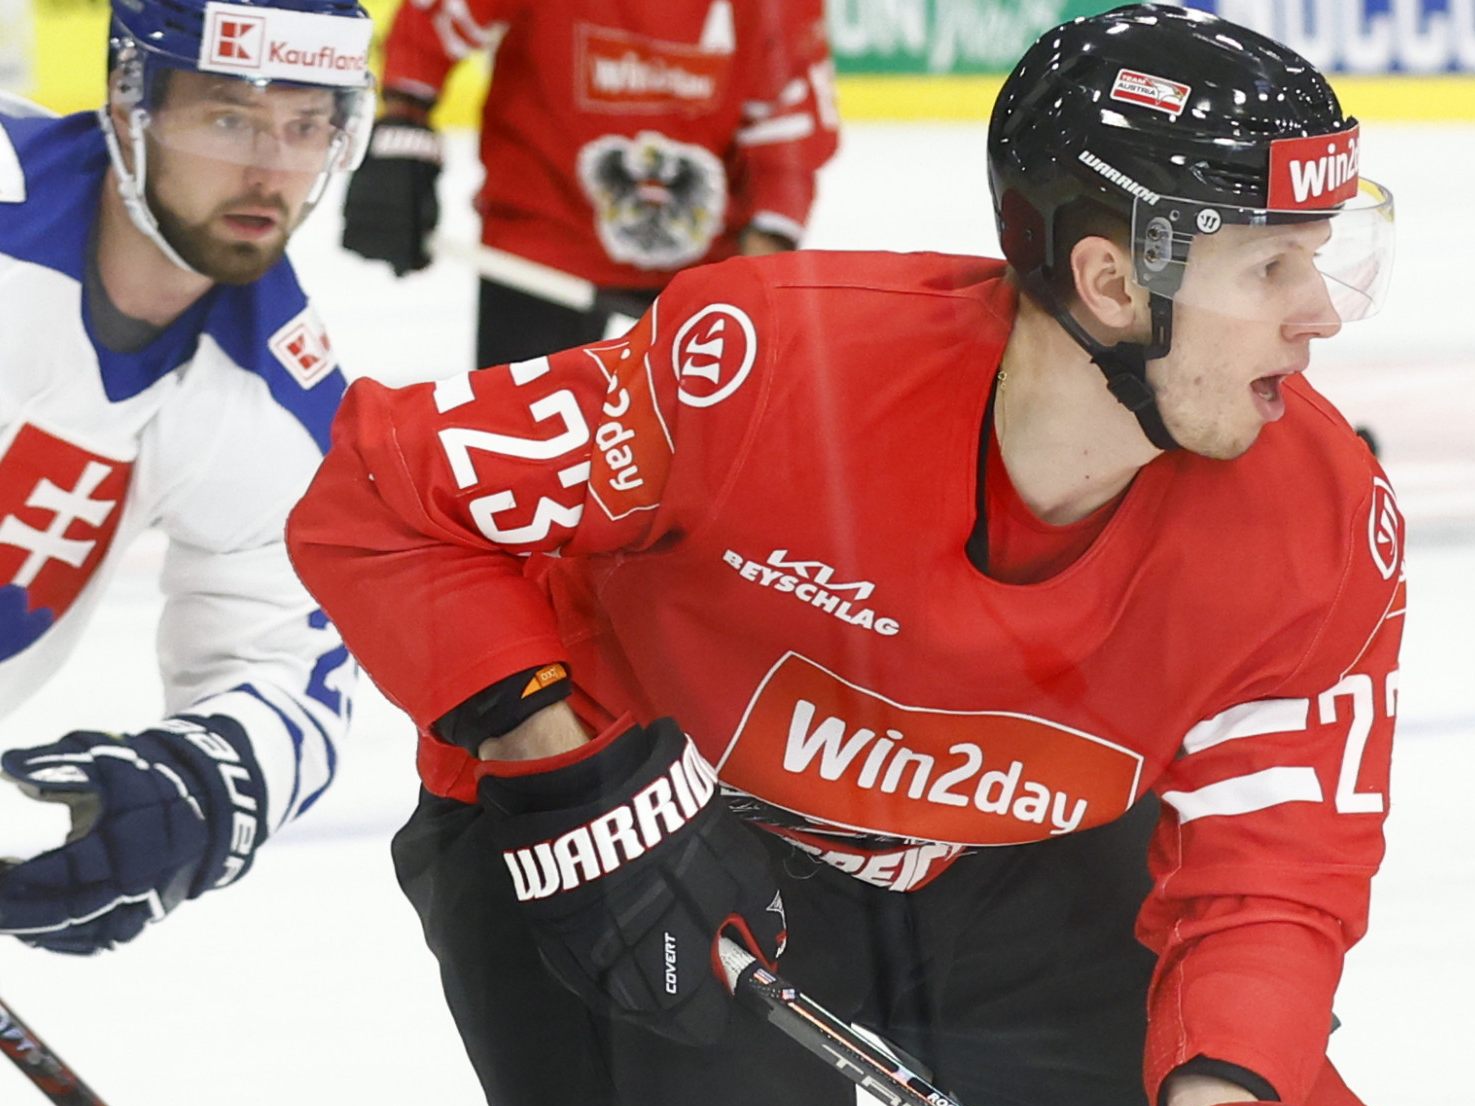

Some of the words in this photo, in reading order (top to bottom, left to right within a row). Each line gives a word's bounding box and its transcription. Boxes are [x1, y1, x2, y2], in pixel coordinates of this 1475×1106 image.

[1078, 150, 1160, 206] WARRIOR
[722, 549, 900, 636] BEYSCHLAG
[783, 699, 1088, 835] Win2day
[664, 931, 677, 994] COVERT
